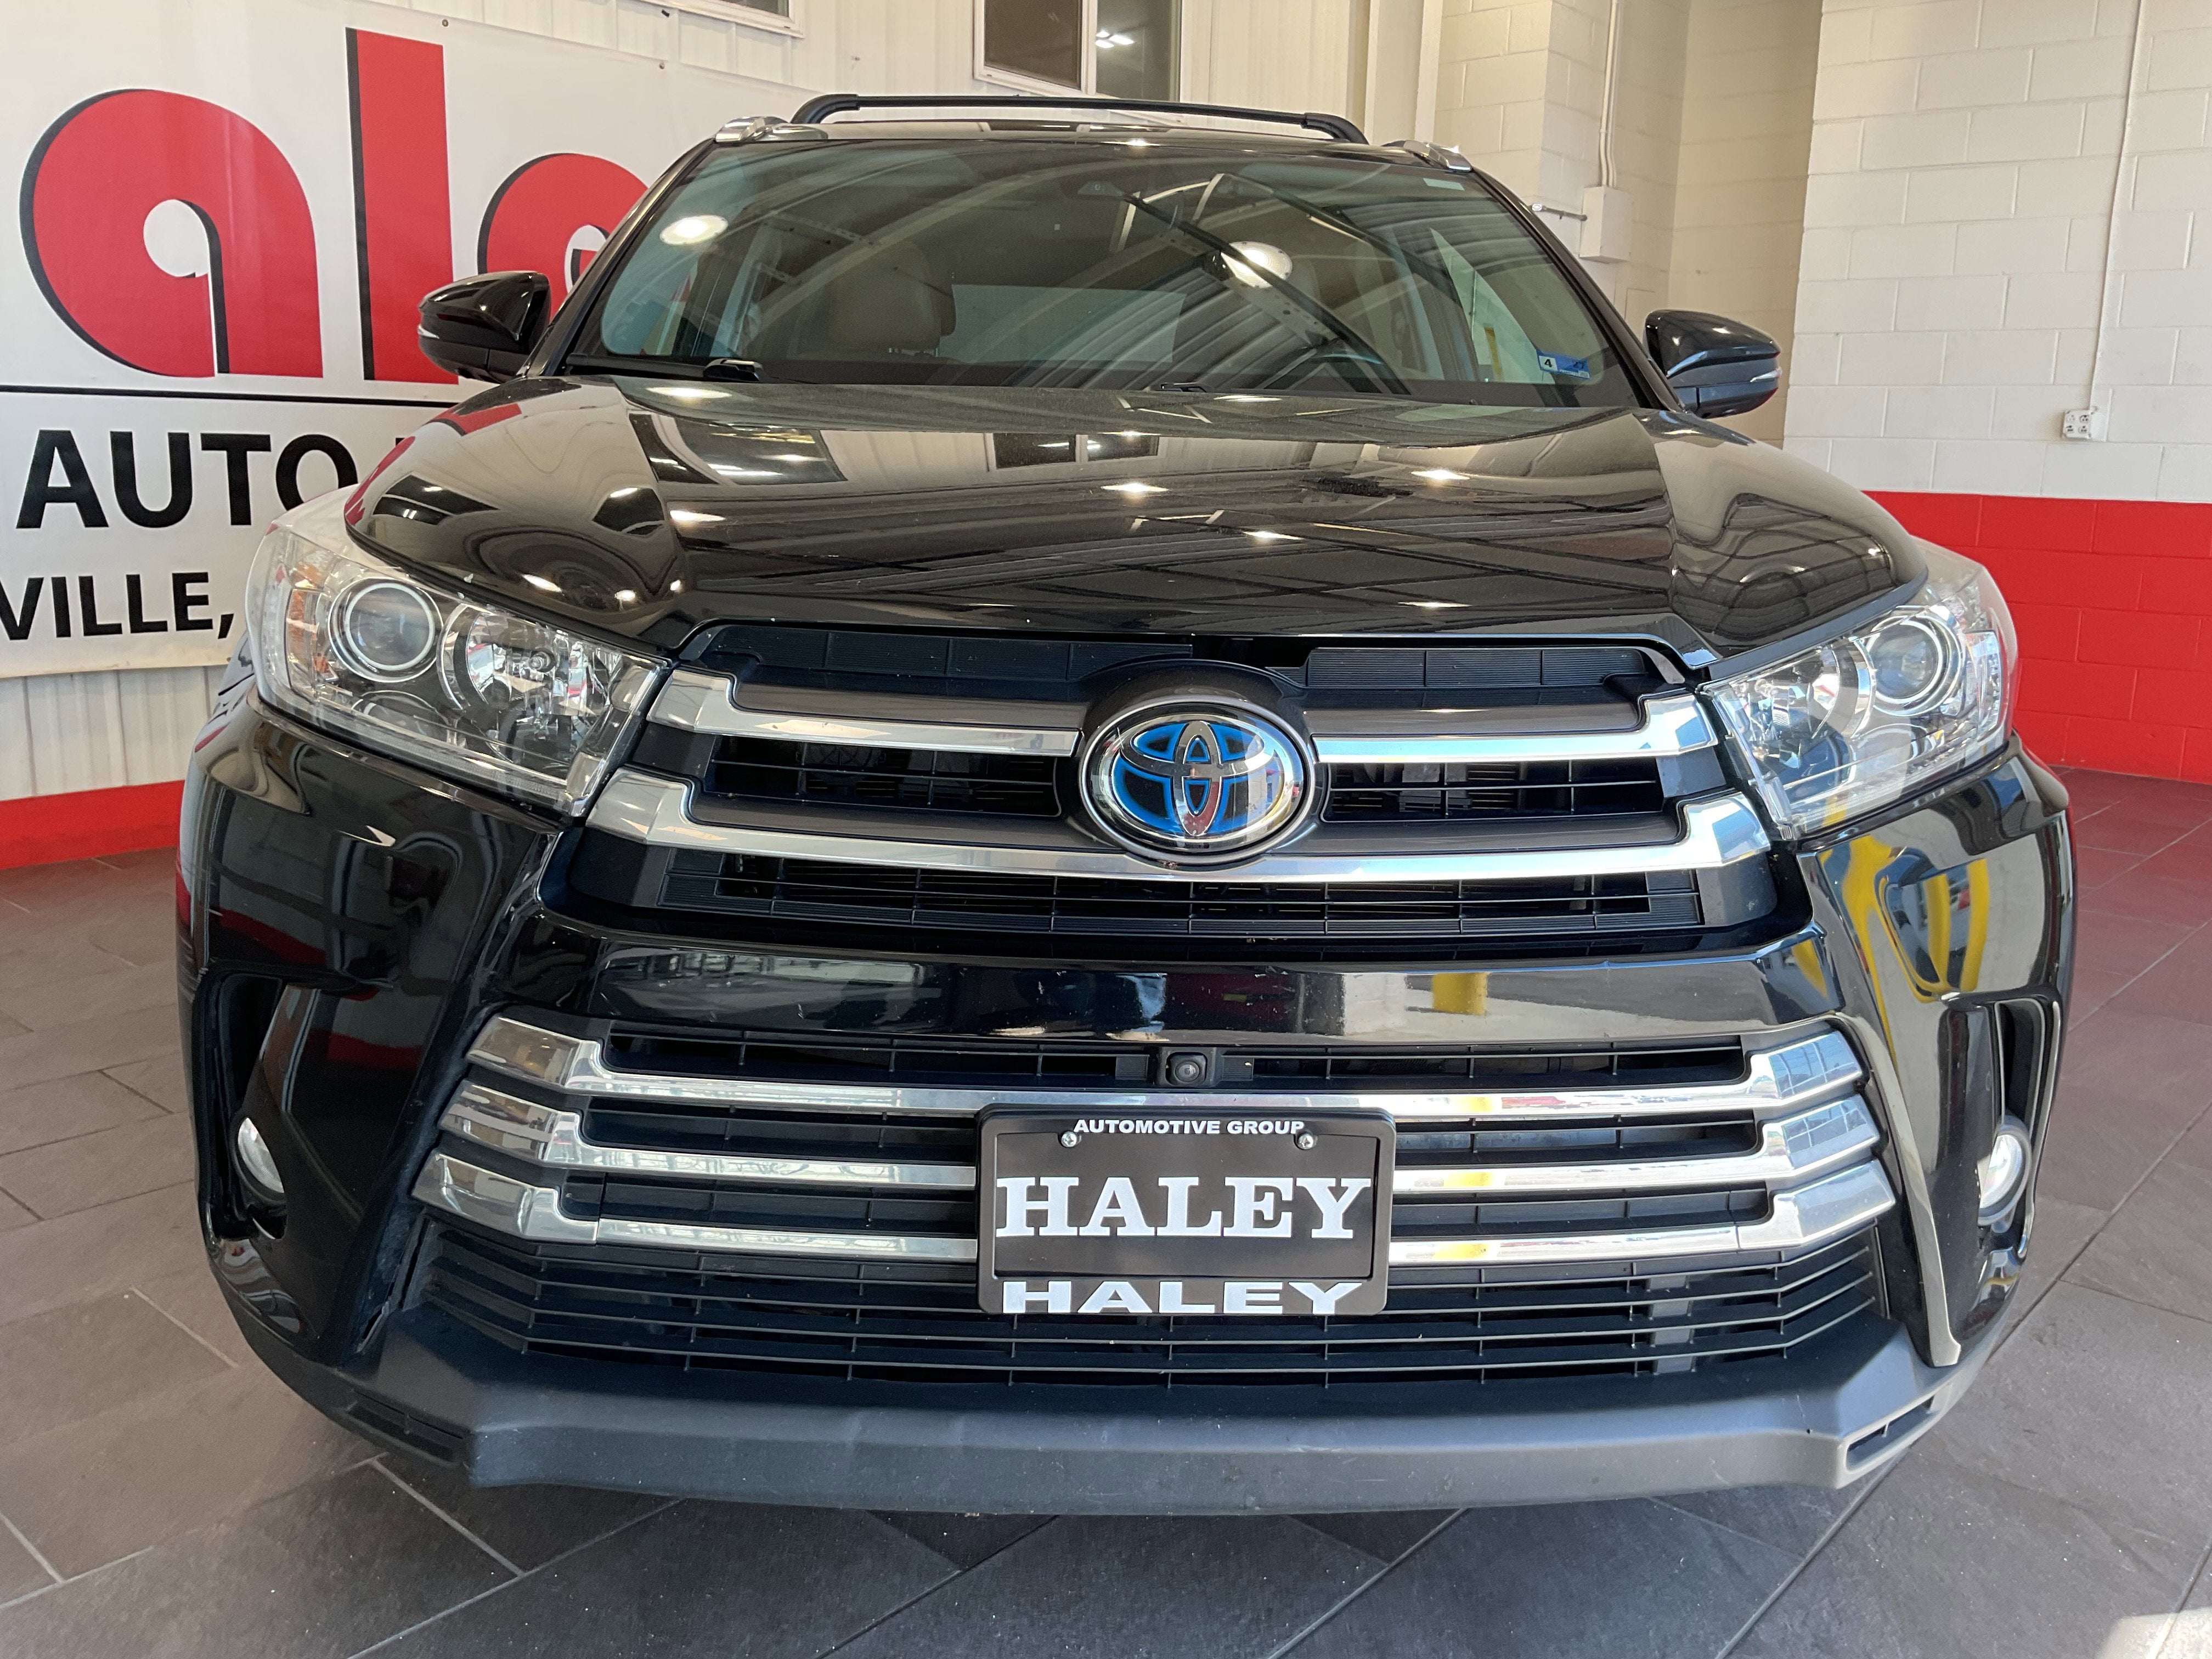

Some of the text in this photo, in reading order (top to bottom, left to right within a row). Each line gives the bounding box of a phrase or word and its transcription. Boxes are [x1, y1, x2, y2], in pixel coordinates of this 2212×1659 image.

[1544, 358, 1553, 368] 4
[15, 429, 358, 529] AUTO
[0, 572, 235, 641] VILLE,
[1074, 1119, 1305, 1135] AUTOMOTIVE GROUP
[996, 1176, 1372, 1239] HALEY
[1003, 1281, 1363, 1314] HALEY
